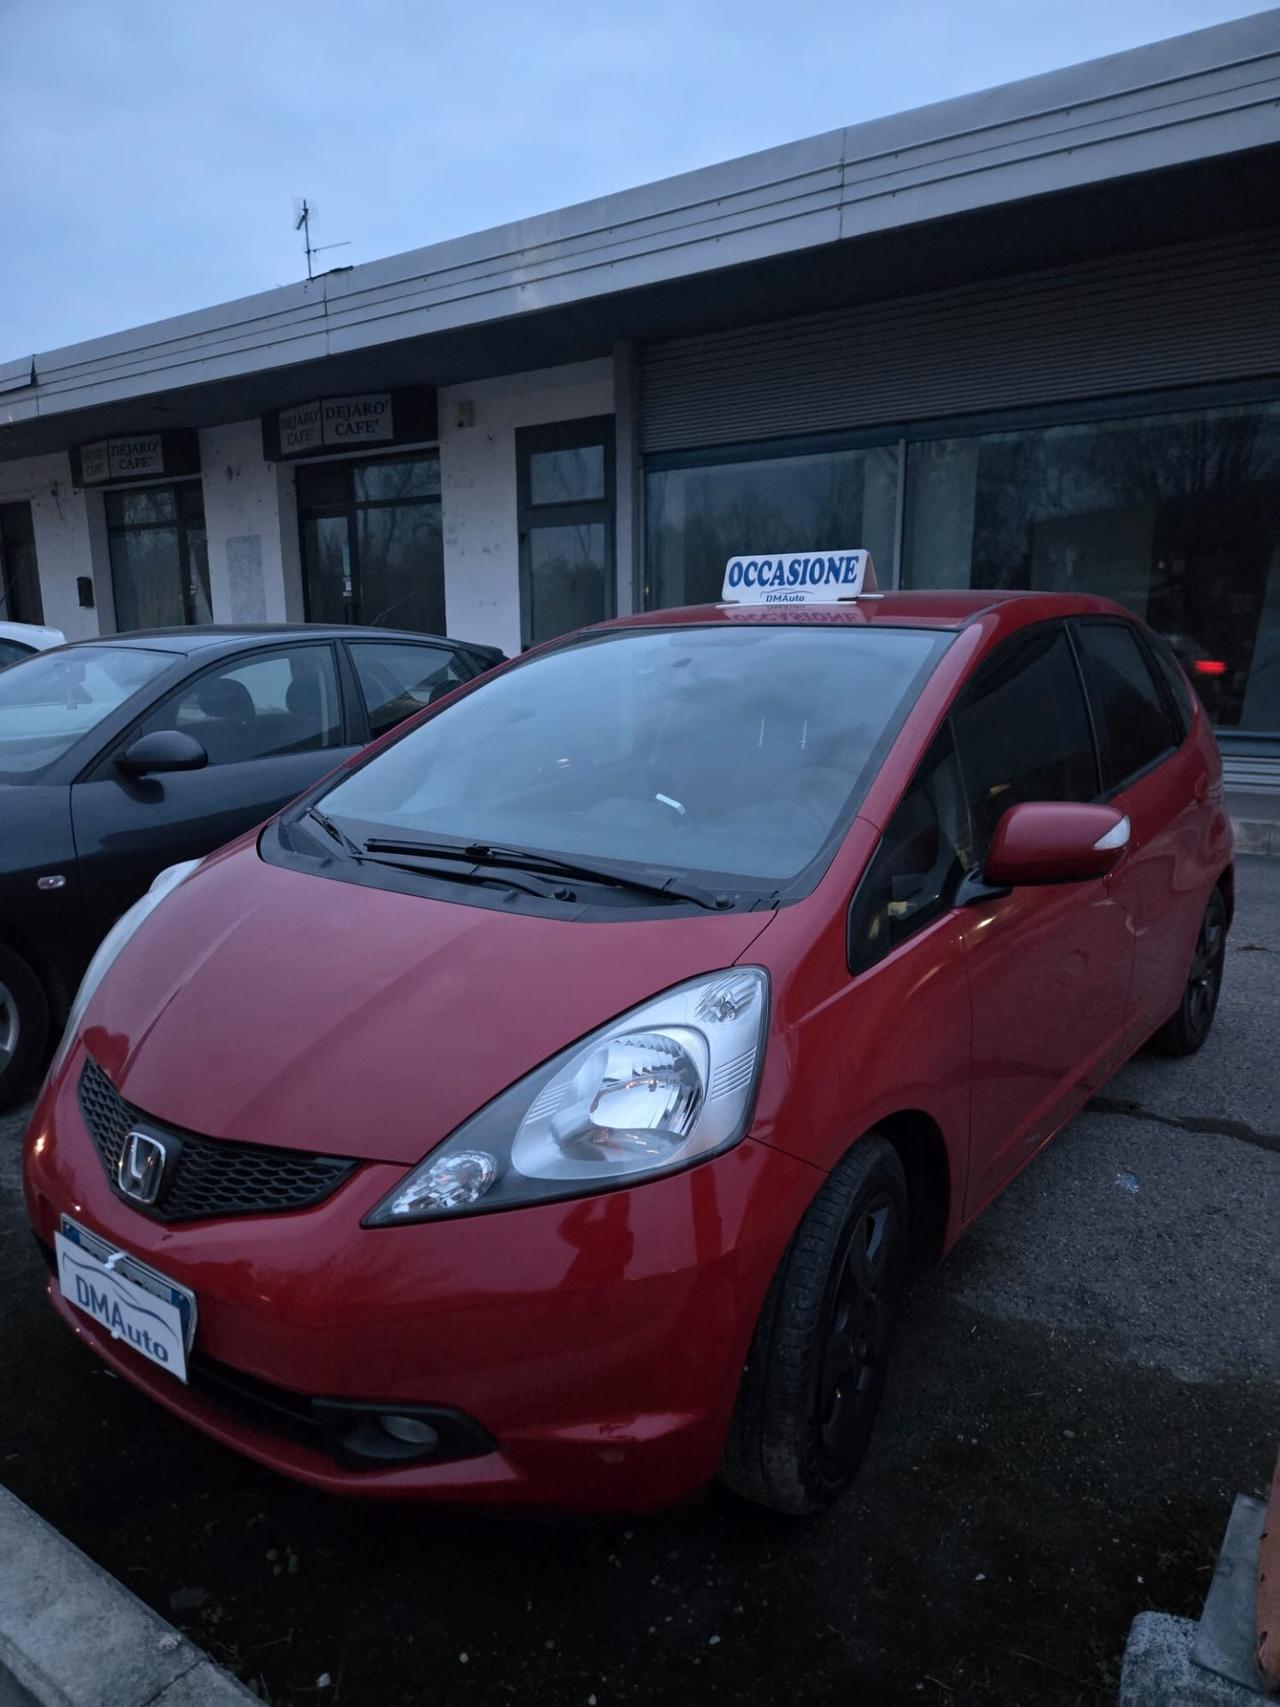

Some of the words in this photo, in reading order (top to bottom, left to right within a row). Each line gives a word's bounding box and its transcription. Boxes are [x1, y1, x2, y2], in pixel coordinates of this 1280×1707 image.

[325, 400, 389, 421] DEJARO'
[335, 419, 379, 436] CAFE'
[728, 556, 859, 587] OCCASIONE
[766, 594, 805, 602] DMAuto
[75, 1274, 169, 1362] DMAuto
